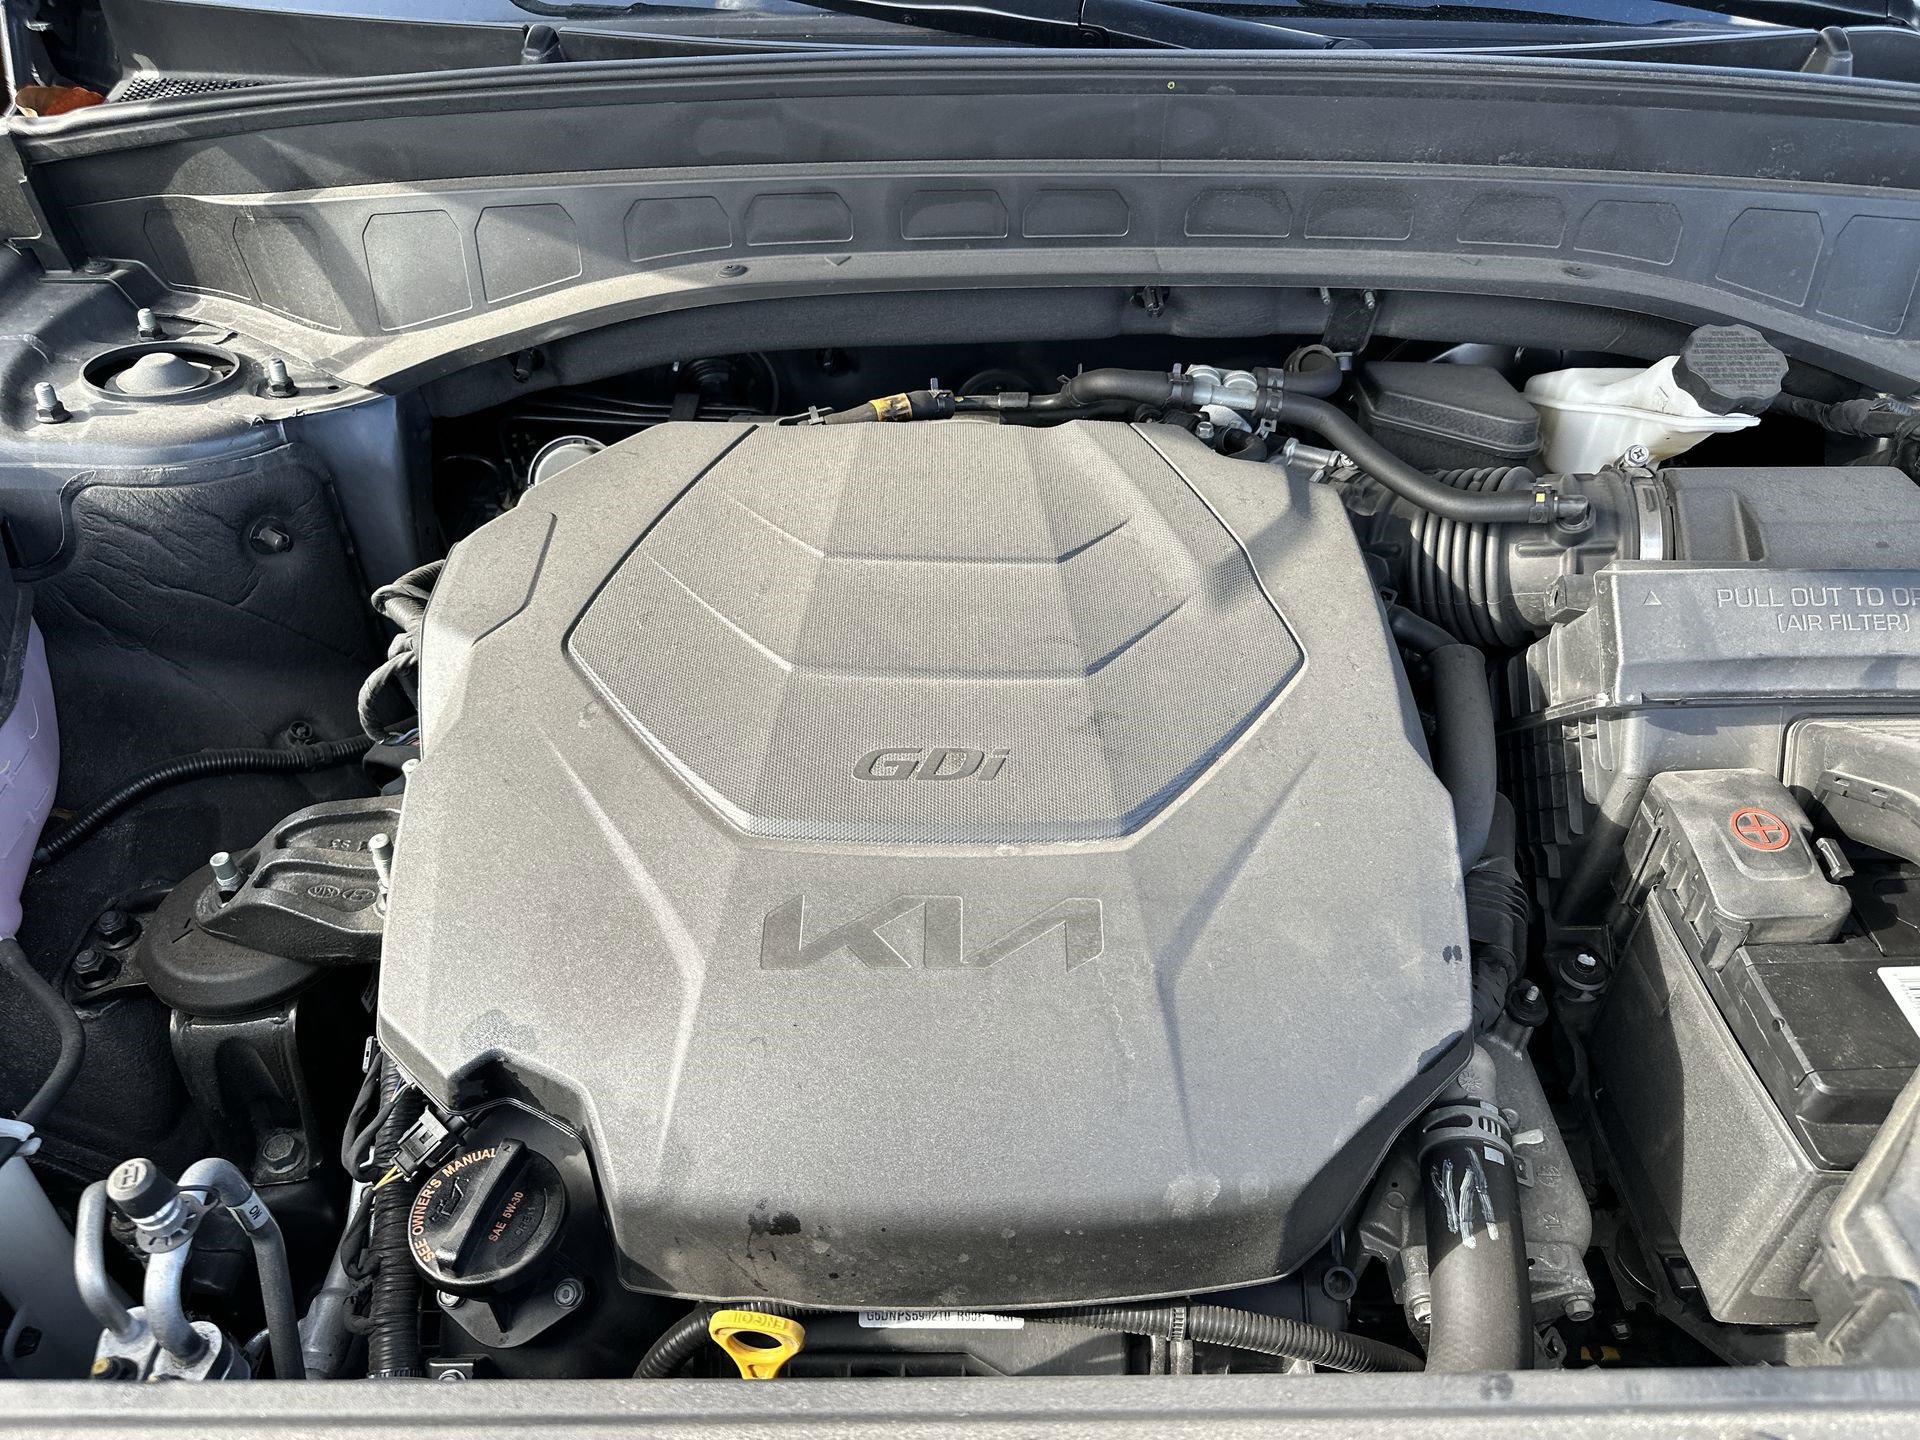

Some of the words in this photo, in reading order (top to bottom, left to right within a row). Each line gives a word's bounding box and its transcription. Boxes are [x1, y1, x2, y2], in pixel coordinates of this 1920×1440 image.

[1716, 587, 1784, 608] PULL
[1790, 587, 1842, 608] OUT
[1849, 587, 1885, 607] TO
[852, 747, 1010, 781] GDi
[760, 894, 1104, 973] KIA
[441, 1148, 496, 1178] MANUAL
[412, 1178, 442, 1236] OWNER'S
[488, 1222, 507, 1243] SAE
[502, 1191, 524, 1219] 5W-30
[414, 1238, 436, 1262] SEE
